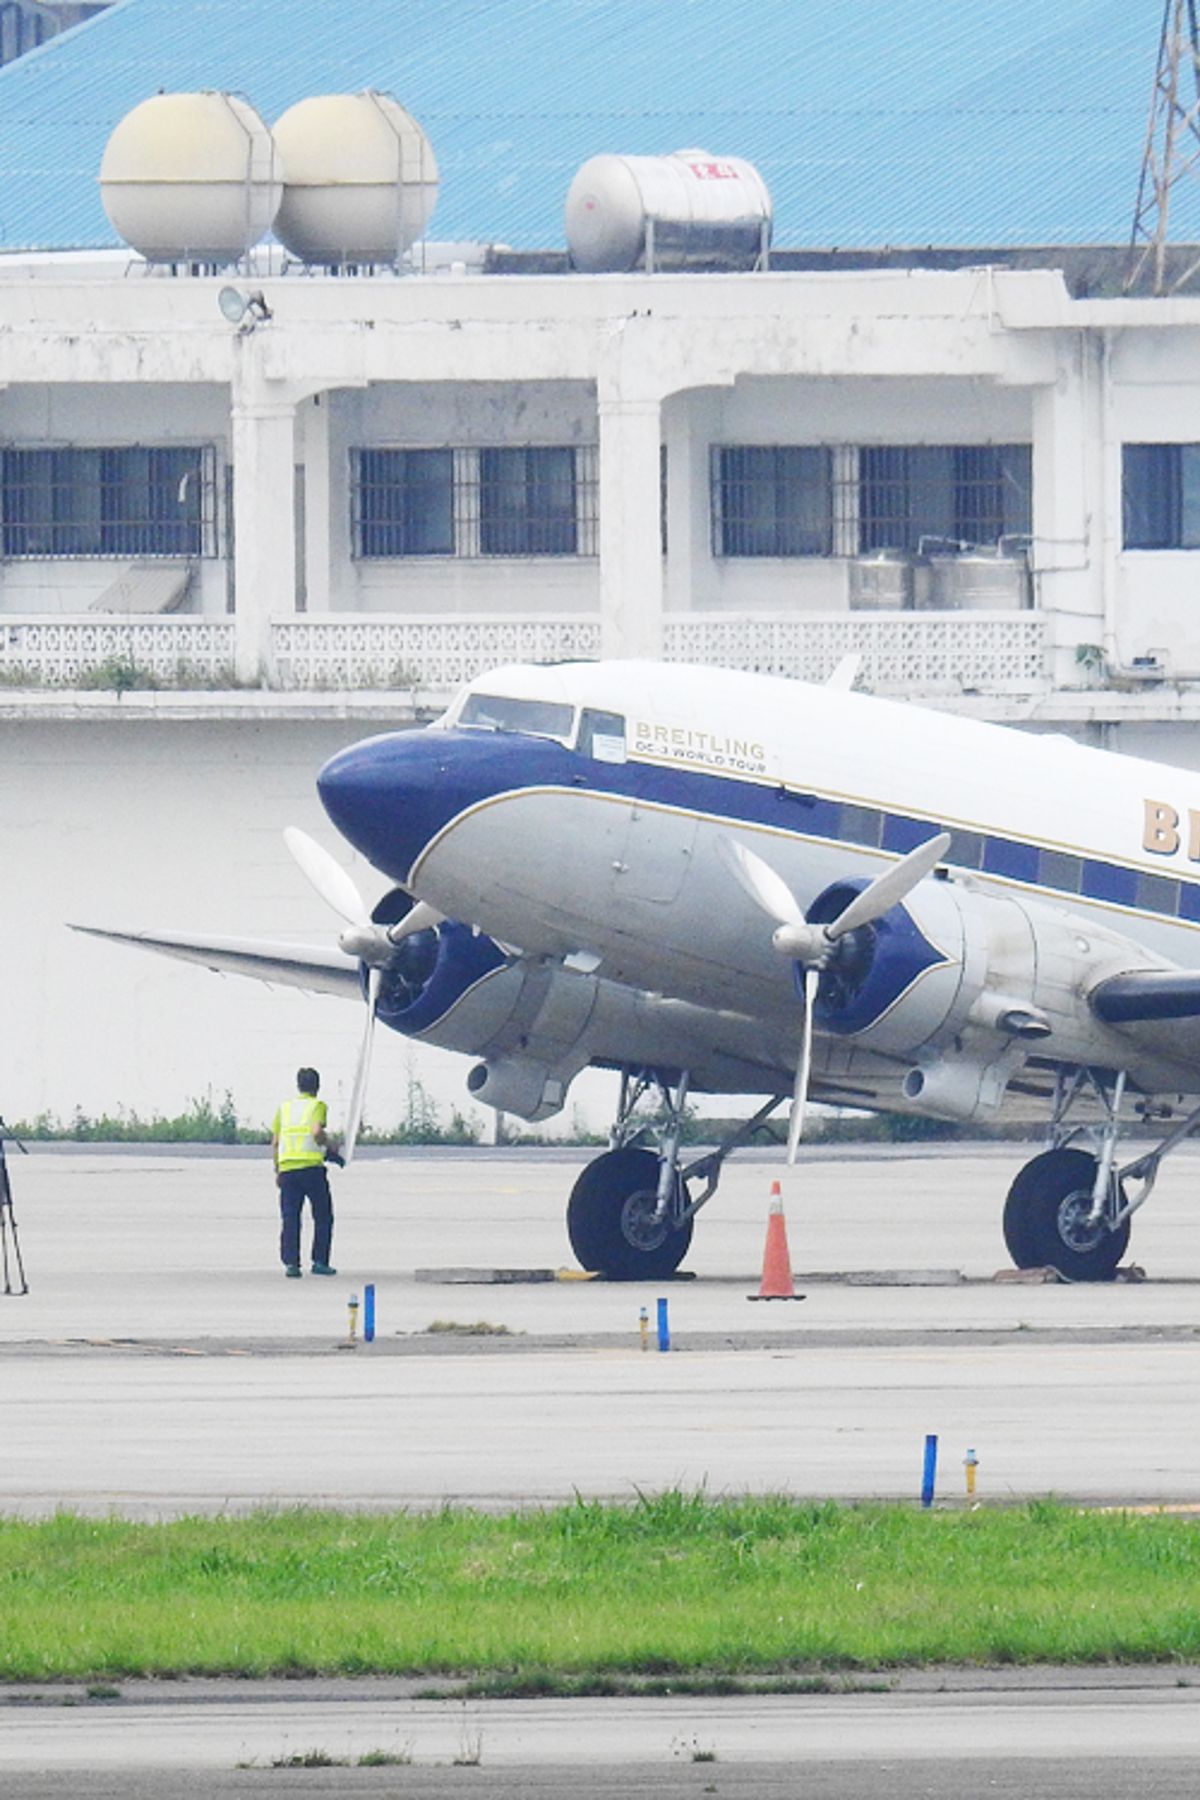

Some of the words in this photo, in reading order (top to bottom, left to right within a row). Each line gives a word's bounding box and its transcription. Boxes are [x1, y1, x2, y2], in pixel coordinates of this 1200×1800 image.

[636, 722, 766, 759] BREITLING
[673, 747, 725, 765] WORLD
[729, 757, 767, 774] TOUR
